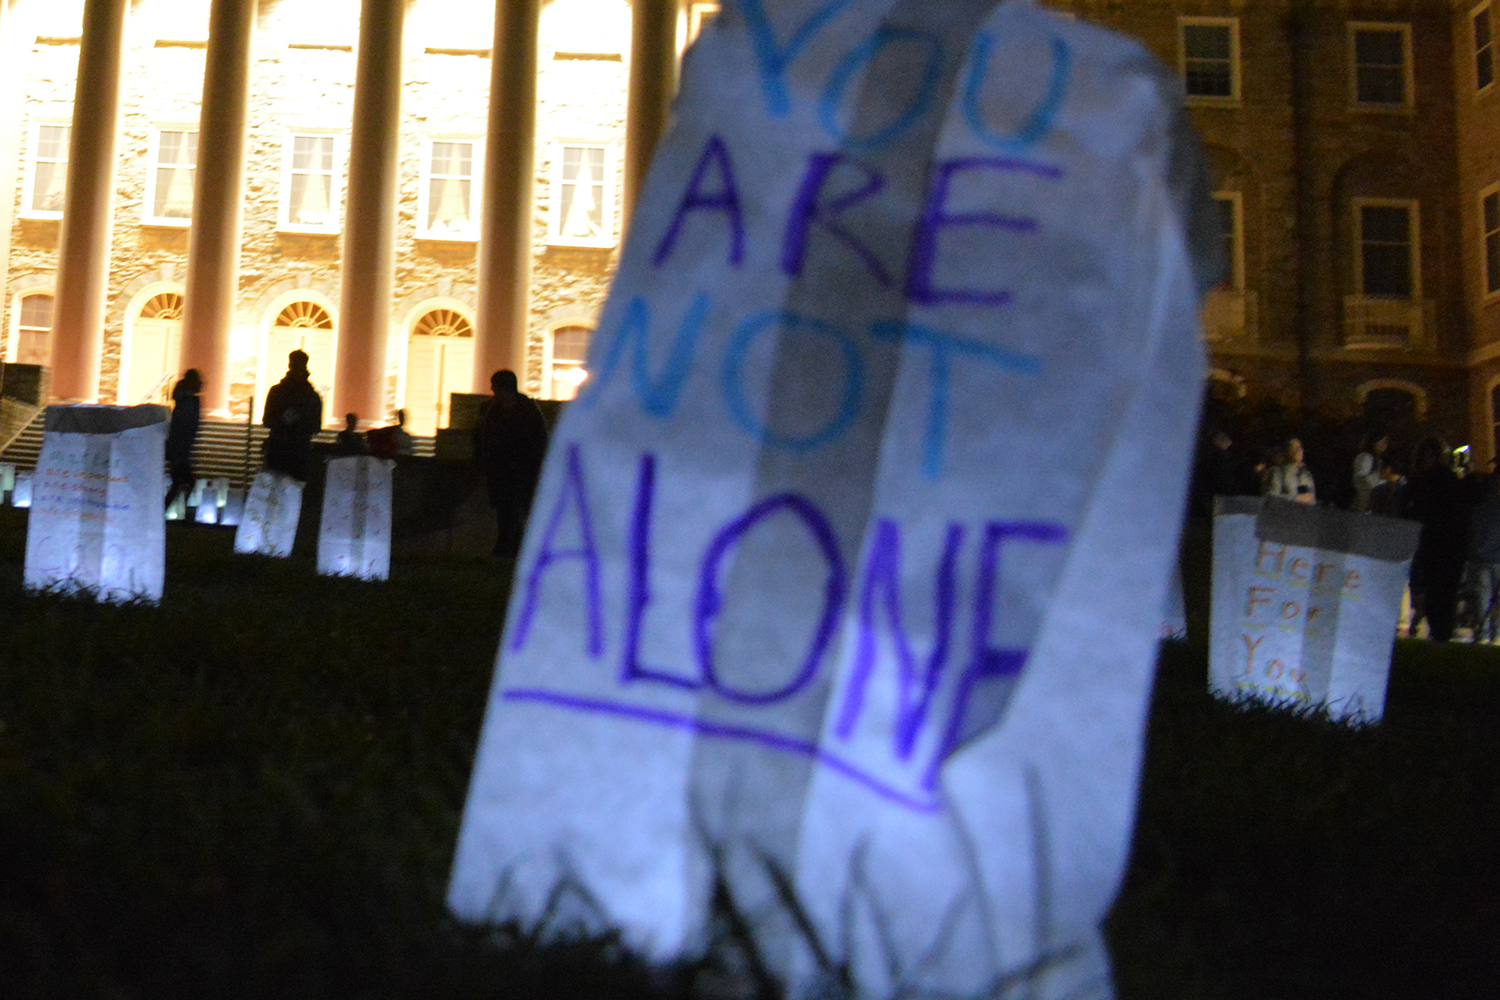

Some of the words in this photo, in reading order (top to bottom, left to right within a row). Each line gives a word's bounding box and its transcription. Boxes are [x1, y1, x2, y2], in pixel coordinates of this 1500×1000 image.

[651, 132, 1067, 308] ARE
[583, 290, 1042, 480] NOT
[509, 441, 1072, 793] ALONE
[1246, 586, 1322, 620] For
[1255, 541, 1362, 590] Here
[1243, 633, 1306, 683] You
